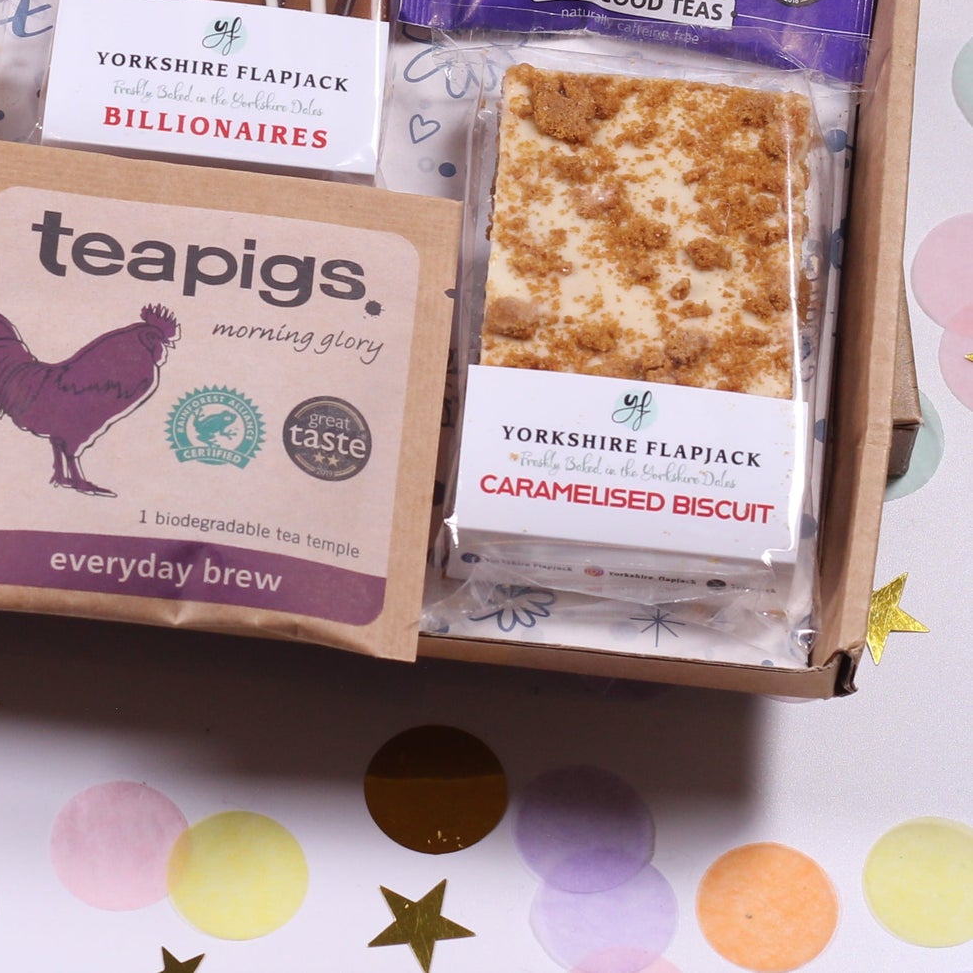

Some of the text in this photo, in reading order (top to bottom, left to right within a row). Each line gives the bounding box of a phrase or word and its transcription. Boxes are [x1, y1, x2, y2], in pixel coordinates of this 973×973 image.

[561, 7, 700, 45] naturally caffeine free
[97, 51, 349, 92] YORKSHIRE FLAPJACK
[113, 79, 153, 103] Freshly
[158, 81, 192, 103] Baked
[211, 87, 227, 106] the
[231, 90, 287, 113] Yorkshire
[290, 99, 323, 117] Dales
[103, 106, 328, 149] BILLIONAIRES
[212, 322, 384, 364] morning glory
[177, 395, 255, 441] RAINFOREST ALLIANCE
[308, 413, 350, 429] great
[183, 449, 242, 464] CERTIFIED
[289, 424, 367, 458] taste
[502, 425, 761, 467] YORKSHIRE FLAPJACK
[520, 449, 560, 476] Freshly
[565, 452, 602, 475] Baked
[620, 459, 638, 477] the
[642, 463, 700, 486] Yorkshire
[702, 470, 737, 489] Dales
[479, 474, 775, 524] CARAMELISED BISCUIT
[137, 509, 360, 559] 1 biodegradable tea temple
[50, 550, 283, 592] everyday brew
